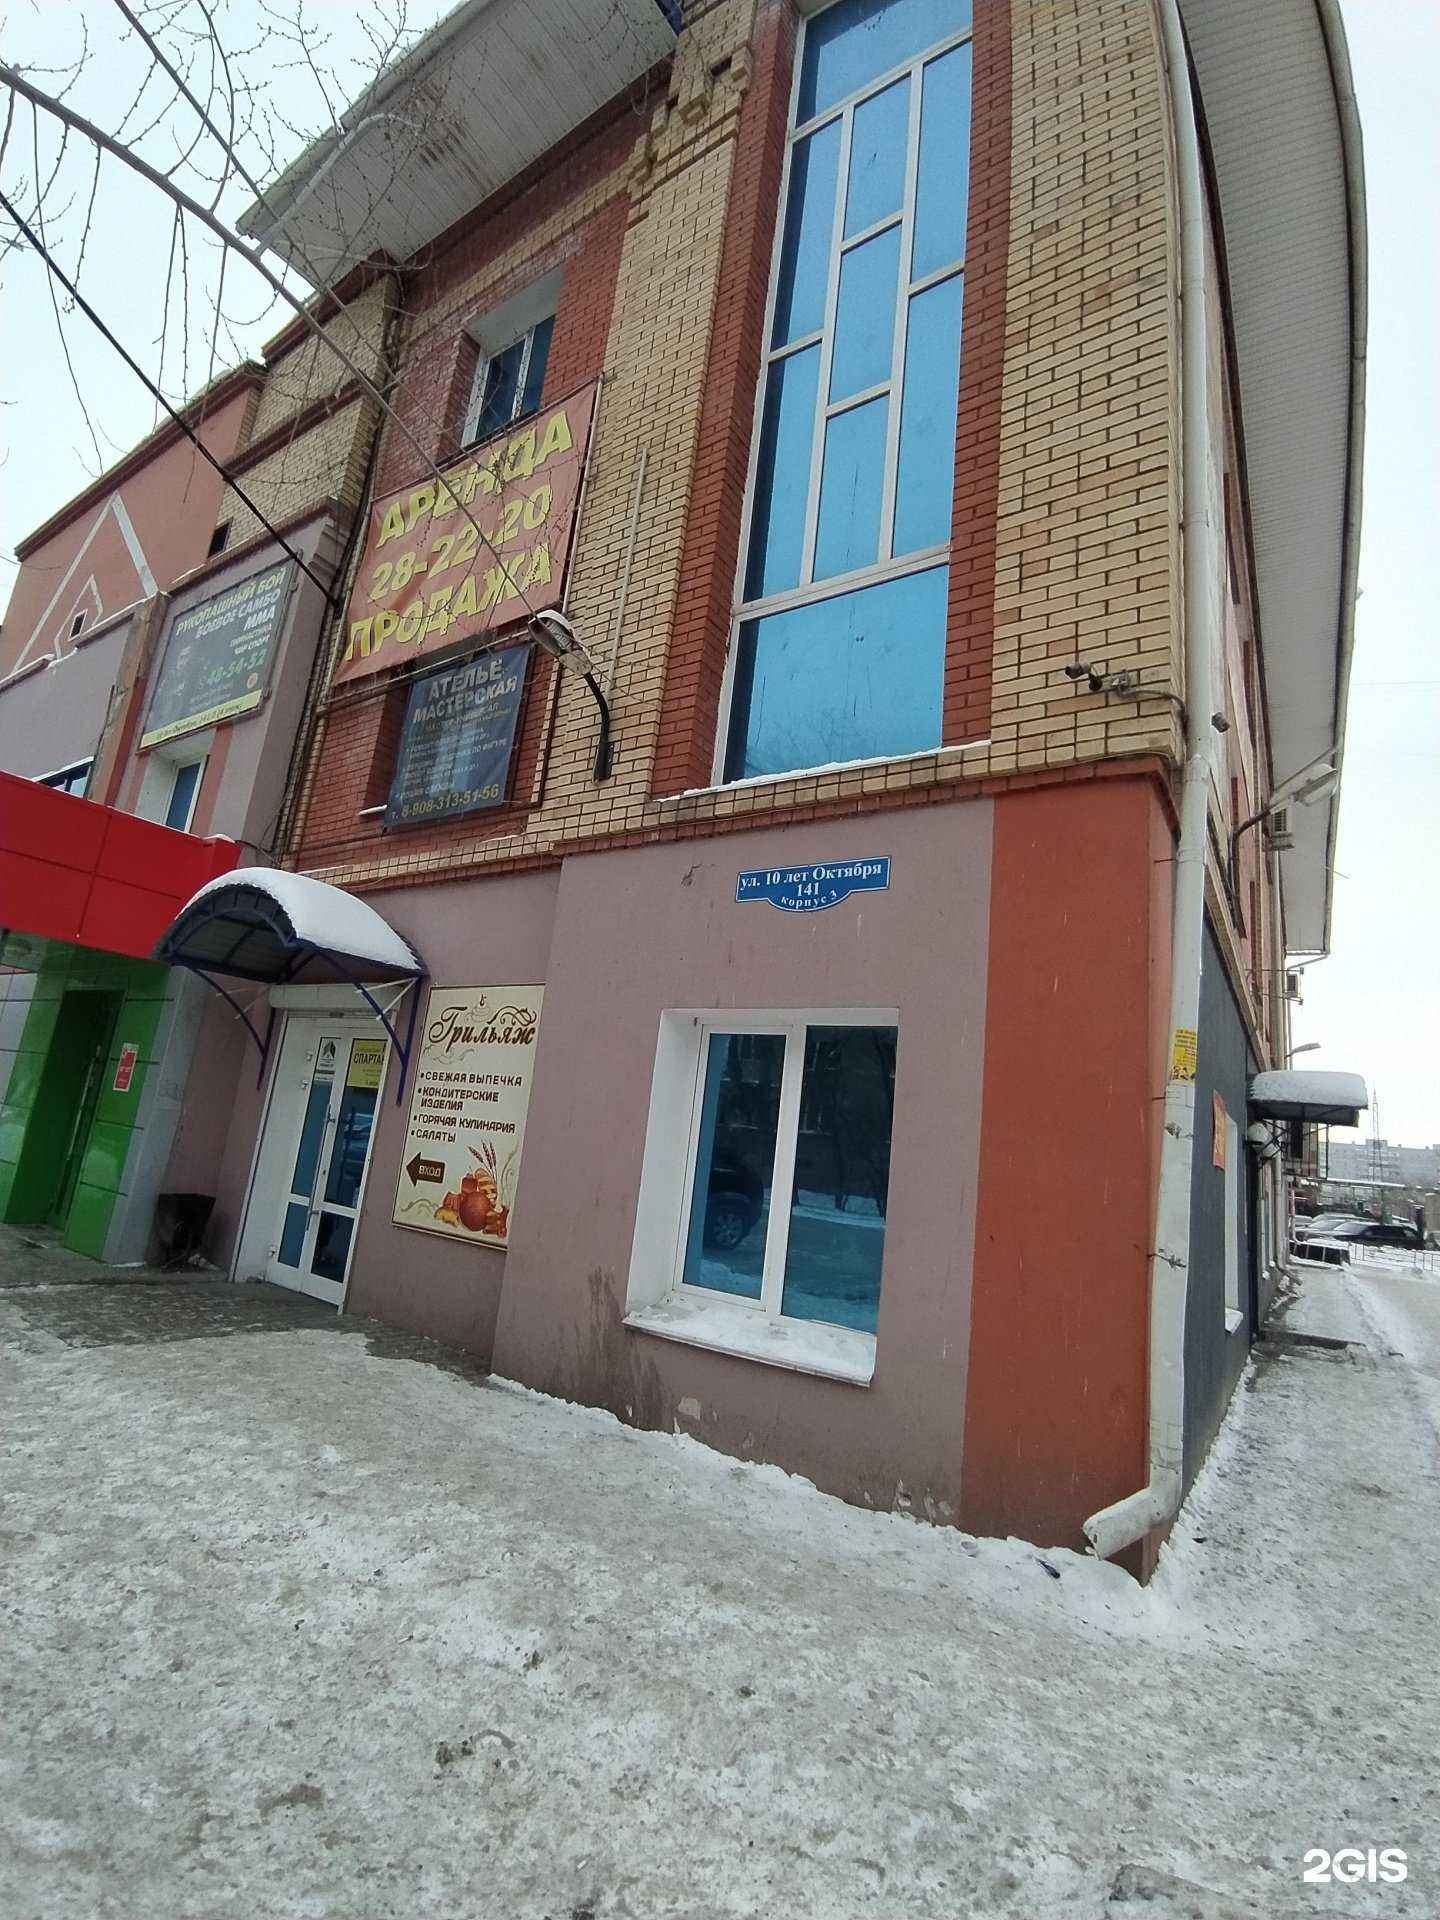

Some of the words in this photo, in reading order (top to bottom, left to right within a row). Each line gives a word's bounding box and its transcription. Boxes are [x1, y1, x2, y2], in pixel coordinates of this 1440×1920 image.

[375, 410, 573, 549] АРЕНДА
[368, 485, 553, 602] 28-22-20
[345, 543, 552, 661] ПРОДАЖА
[413, 676, 518, 724] МАСТЕРСКАЯ
[740, 877, 761, 891] ул.
[766, 871, 781, 885] 10
[784, 870, 809, 883] лет
[812, 862, 882, 880] Октября
[797, 882, 820, 897] 141
[781, 896, 827, 909] корпус
[830, 890, 837, 900] 3
[428, 1006, 536, 1052] Грильяж
[425, 1071, 467, 1083] СВЕЖАЯ
[469, 1074, 522, 1087] ВЫПЕЧКА
[422, 1087, 499, 1102] КОНДИТЕРСКИЕ
[420, 1098, 464, 1111] ИЗДЕЛИЯ
[417, 1114, 457, 1127] ГОРЯЧАЯ
[458, 1118, 516, 1134] КУЛИНАРИЯ
[415, 1129, 456, 1143] САЛАТЫ
[418, 1165, 442, 1177] ВХОД
